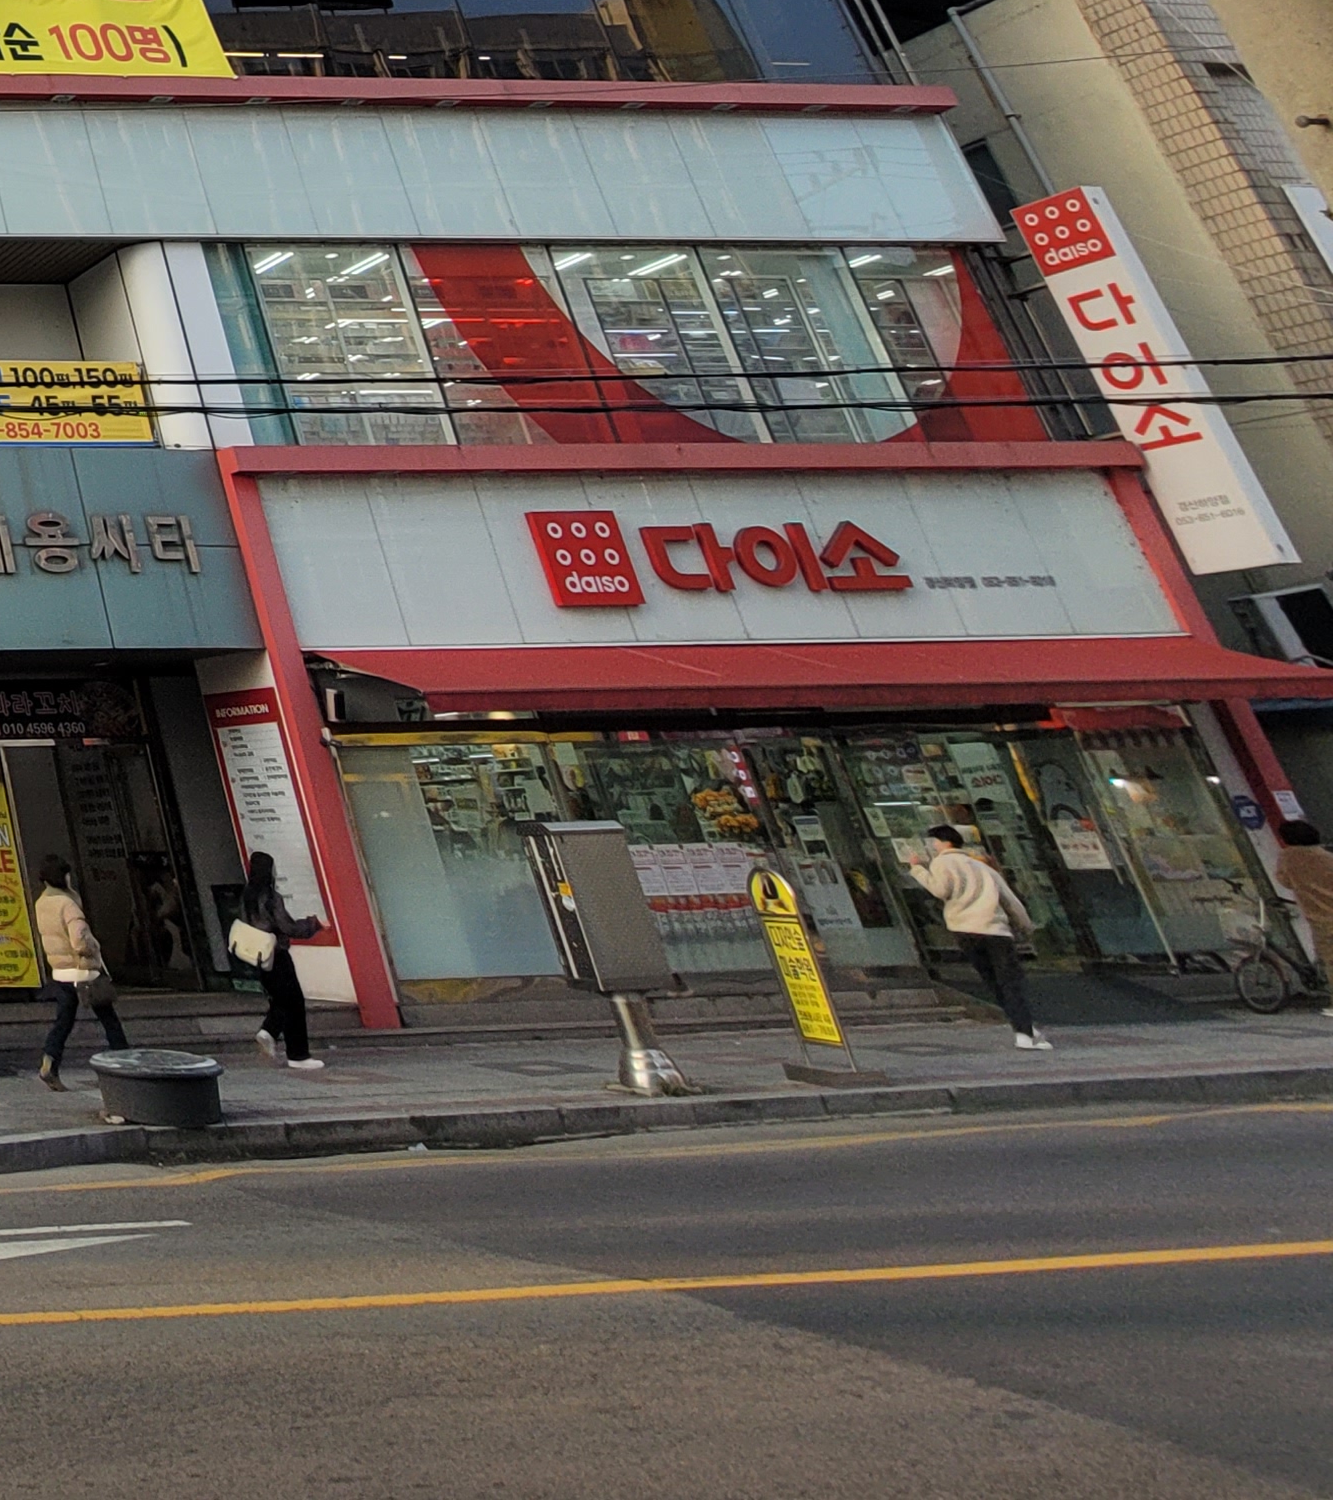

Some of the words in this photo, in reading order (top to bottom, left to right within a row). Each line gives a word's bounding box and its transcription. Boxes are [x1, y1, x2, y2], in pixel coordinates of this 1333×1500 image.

[47, 22, 189, 68] 100명)
[1044, 238, 1103, 267] daiso
[1067, 282, 1204, 452] 다이소
[565, 571, 630, 594] daiso
[639, 520, 914, 592] 다이소
[2, 723, 24, 735] 010
[26, 722, 55, 735] 4596
[57, 721, 85, 734] 4360
[216, 704, 270, 718] INFORMATION
